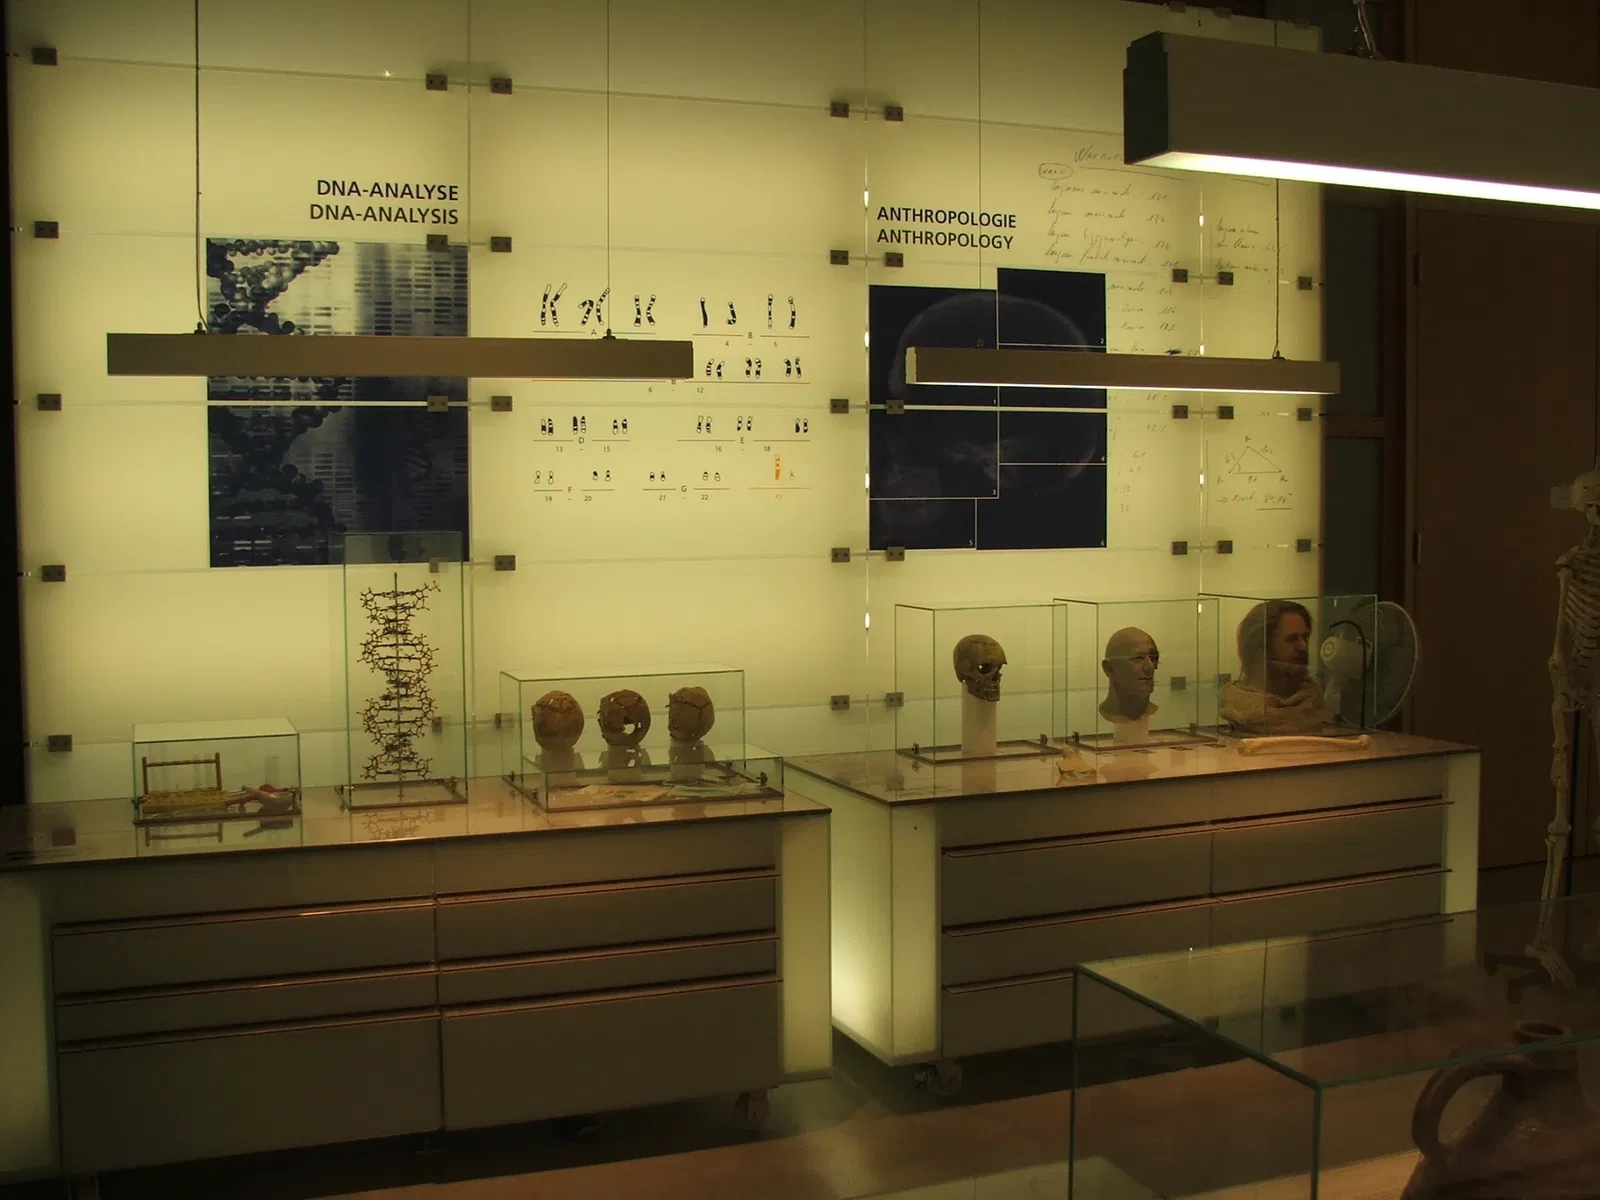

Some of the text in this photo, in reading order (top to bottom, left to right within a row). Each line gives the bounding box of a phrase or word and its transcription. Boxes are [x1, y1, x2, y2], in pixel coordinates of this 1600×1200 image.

[317, 179, 459, 201] DNA-ANALYSE
[310, 203, 459, 225] DNA-ANALYSIS
[877, 206, 1017, 229] ANTHROPOLOGIE
[877, 229, 1014, 250] ANTHROPOLOGY
[591, 328, 597, 336] A
[747, 331, 753, 339] B
[578, 436, 585, 444] D
[740, 436, 745, 444] E
[567, 486, 572, 494] F
[680, 485, 687, 493] G
[583, 494, 593, 502] 20
[700, 493, 709, 501] 22
